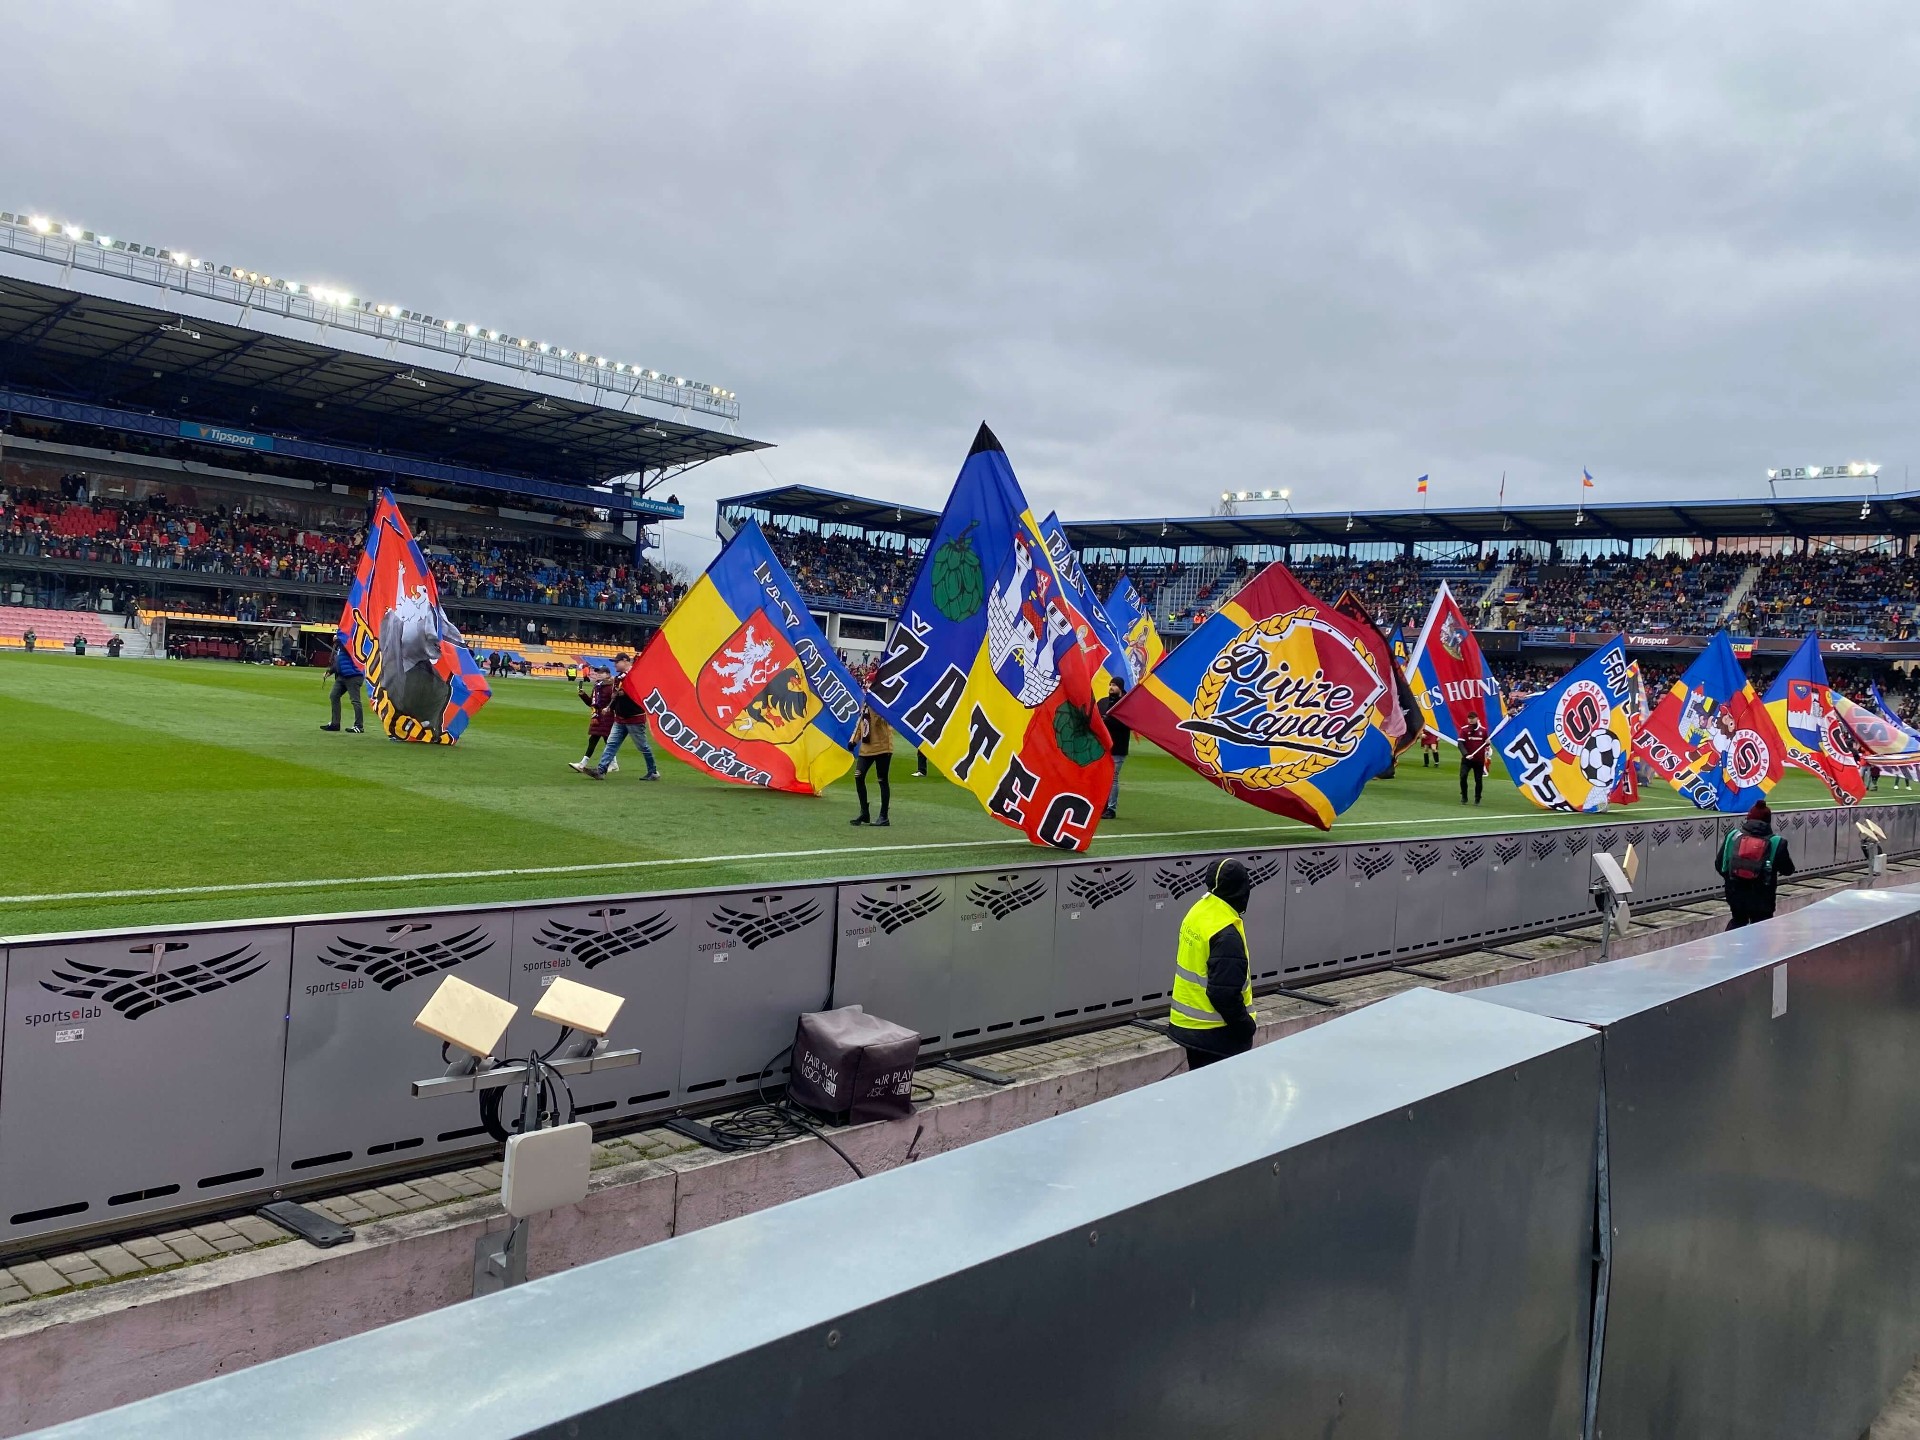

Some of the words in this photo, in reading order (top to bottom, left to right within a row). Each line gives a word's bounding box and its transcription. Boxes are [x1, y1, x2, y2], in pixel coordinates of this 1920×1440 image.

[211, 429, 255, 446] Tipsport
[1637, 636, 1668, 645] Tipsport
[795, 638, 860, 723] CLUB
[1212, 643, 1354, 712] Divize
[1561, 691, 1573, 706] AC
[1578, 682, 1608, 711] SPARTA
[867, 610, 1095, 850] ŽATEC
[1195, 687, 1366, 755] Západ
[1555, 713, 1576, 755] FOTBAL
[643, 688, 772, 787] POLIČKA
[1738, 731, 1765, 753] SPARTA
[1633, 730, 1682, 772] FCS
[1674, 767, 1719, 811] JIČ
[1746, 758, 1769, 786] PRAHA
[698, 939, 737, 952] sportselab
[523, 957, 571, 973] sportselab
[305, 978, 364, 996] sportselab
[25, 1006, 101, 1027] sportselab
[804, 1050, 820, 1070] FAIR
[821, 1062, 839, 1082] PLAY
[892, 1069, 913, 1082] PLAY
